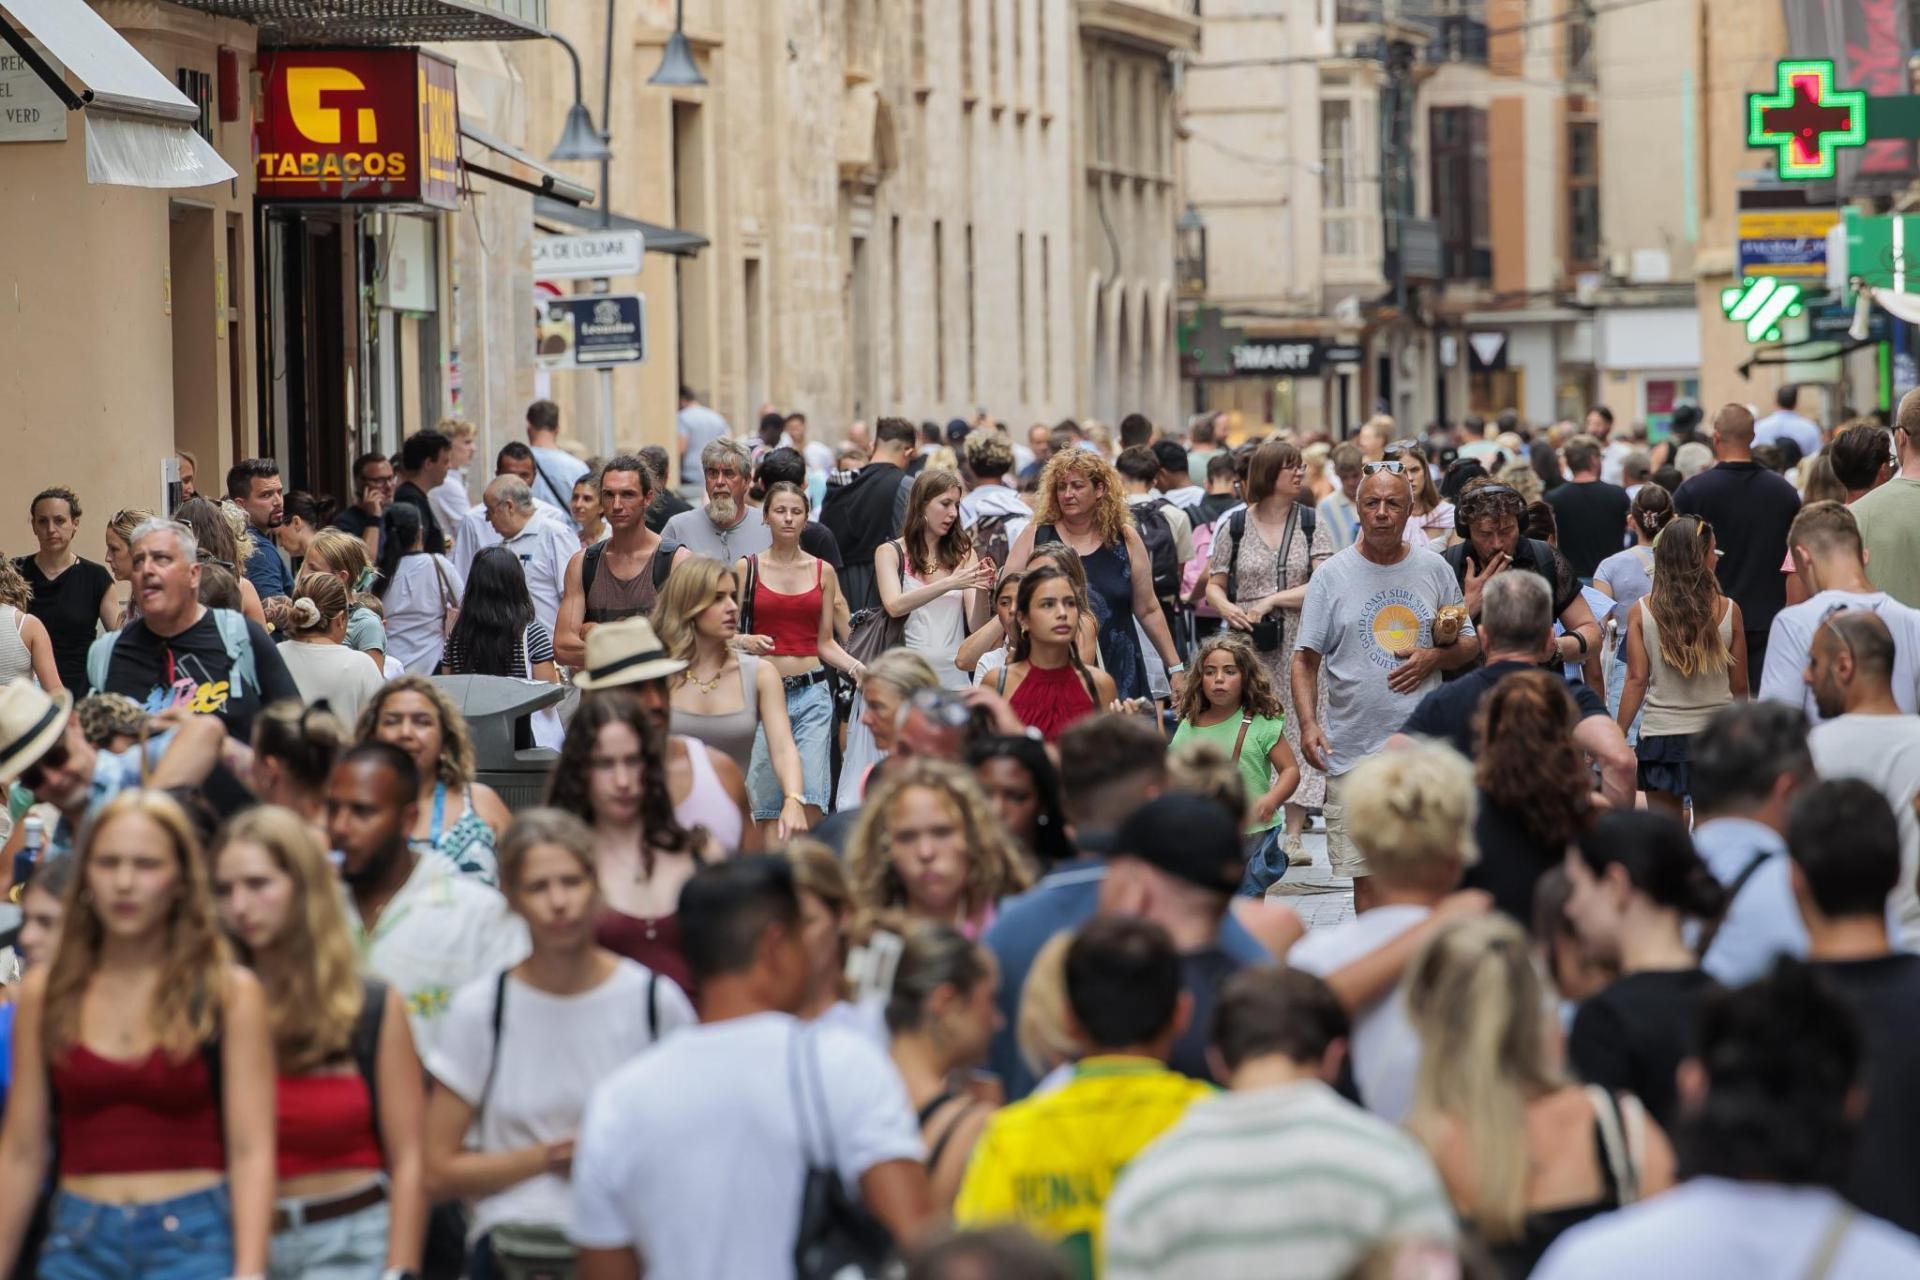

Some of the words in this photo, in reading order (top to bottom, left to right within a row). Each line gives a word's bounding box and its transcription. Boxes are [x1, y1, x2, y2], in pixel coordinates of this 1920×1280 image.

[6, 108, 40, 123] VERD
[259, 153, 406, 176] TABACOS
[1361, 591, 1387, 617] COAST
[1389, 589, 1414, 601] SURF
[1359, 619, 1370, 648] GOLD
